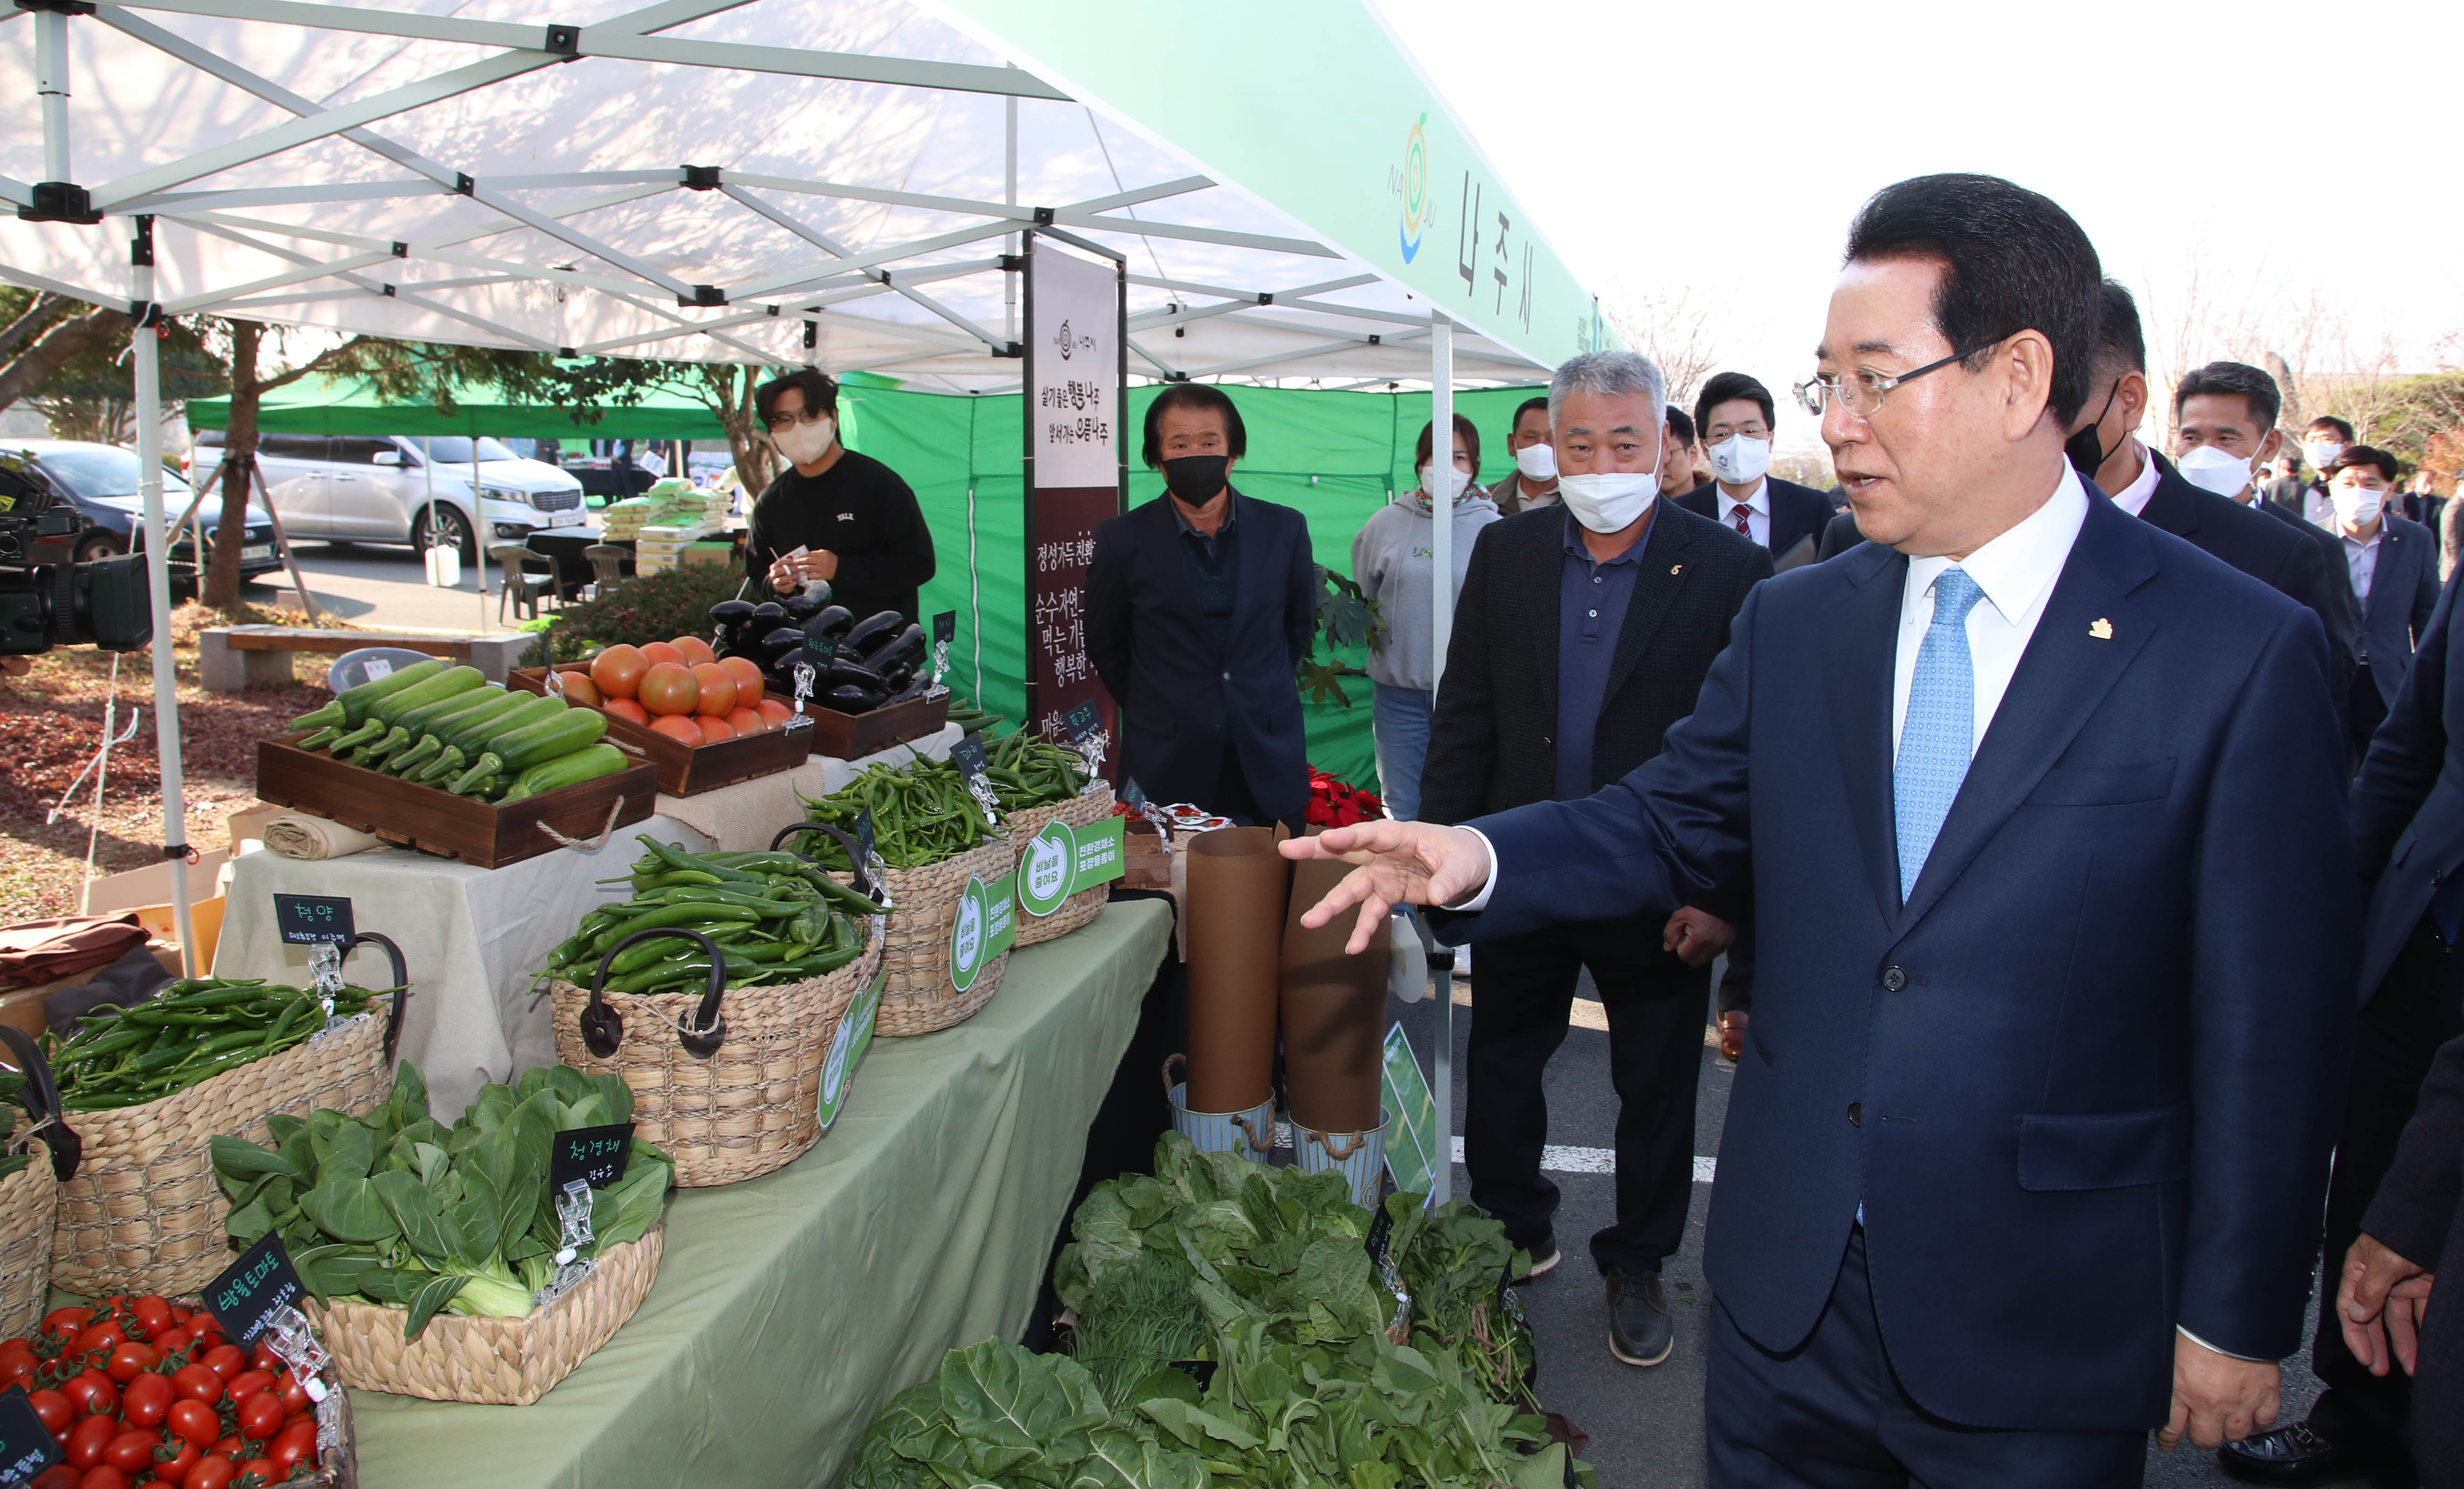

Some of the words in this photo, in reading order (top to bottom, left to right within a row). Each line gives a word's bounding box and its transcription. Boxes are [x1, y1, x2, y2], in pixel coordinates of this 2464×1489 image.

[1459, 169, 1533, 334] 나주시
[1079, 335, 1096, 352] 나주시
[837, 513, 854, 521] YALE
[1037, 541, 1075, 572] 정성가득
[1076, 538, 1097, 566] 친환
[1042, 625, 1067, 657] 먹는
[1054, 650, 1087, 688] 행복한
[1079, 836, 1115, 858] 친환경채소
[1036, 855, 1058, 873] 비닐을
[1079, 849, 1115, 872] 포장용종이
[1035, 871, 1058, 889] 줄여요
[294, 903, 333, 921] 청양
[570, 1138, 620, 1161] 청경채
[218, 1251, 279, 1311] 방울토마토
